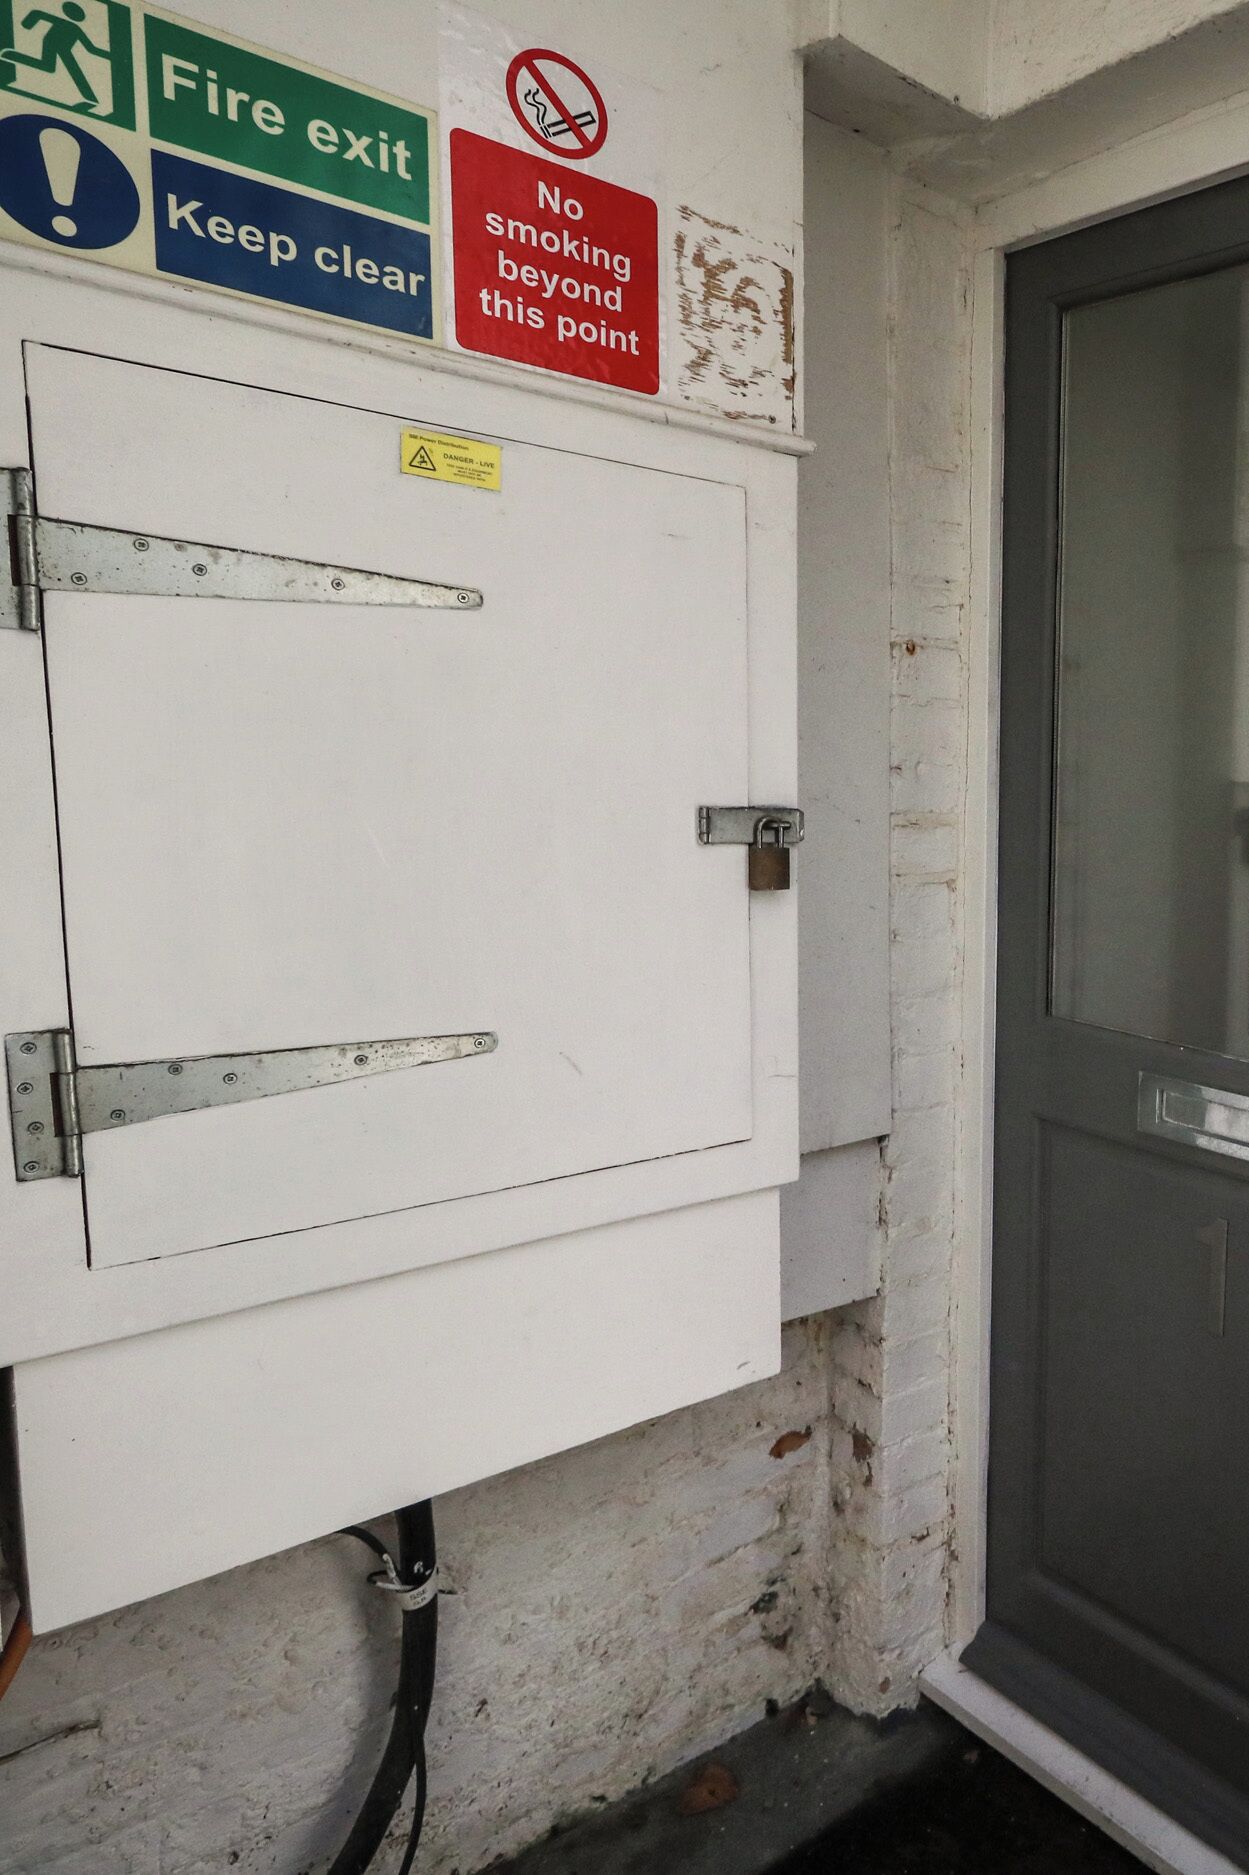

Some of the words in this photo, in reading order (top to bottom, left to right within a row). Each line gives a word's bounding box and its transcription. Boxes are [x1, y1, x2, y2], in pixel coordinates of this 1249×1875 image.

[162, 53, 285, 135] Fire
[307, 118, 412, 181] exit
[537, 180, 584, 221] No
[167, 193, 298, 267] Keep
[314, 244, 425, 296] clear
[485, 212, 631, 283] smoking
[498, 250, 622, 312] beyond
[479, 287, 545, 329] this
[558, 314, 639, 356] point
[443, 452, 474, 465] DANGER
[479, 461, 495, 469] LIVE
